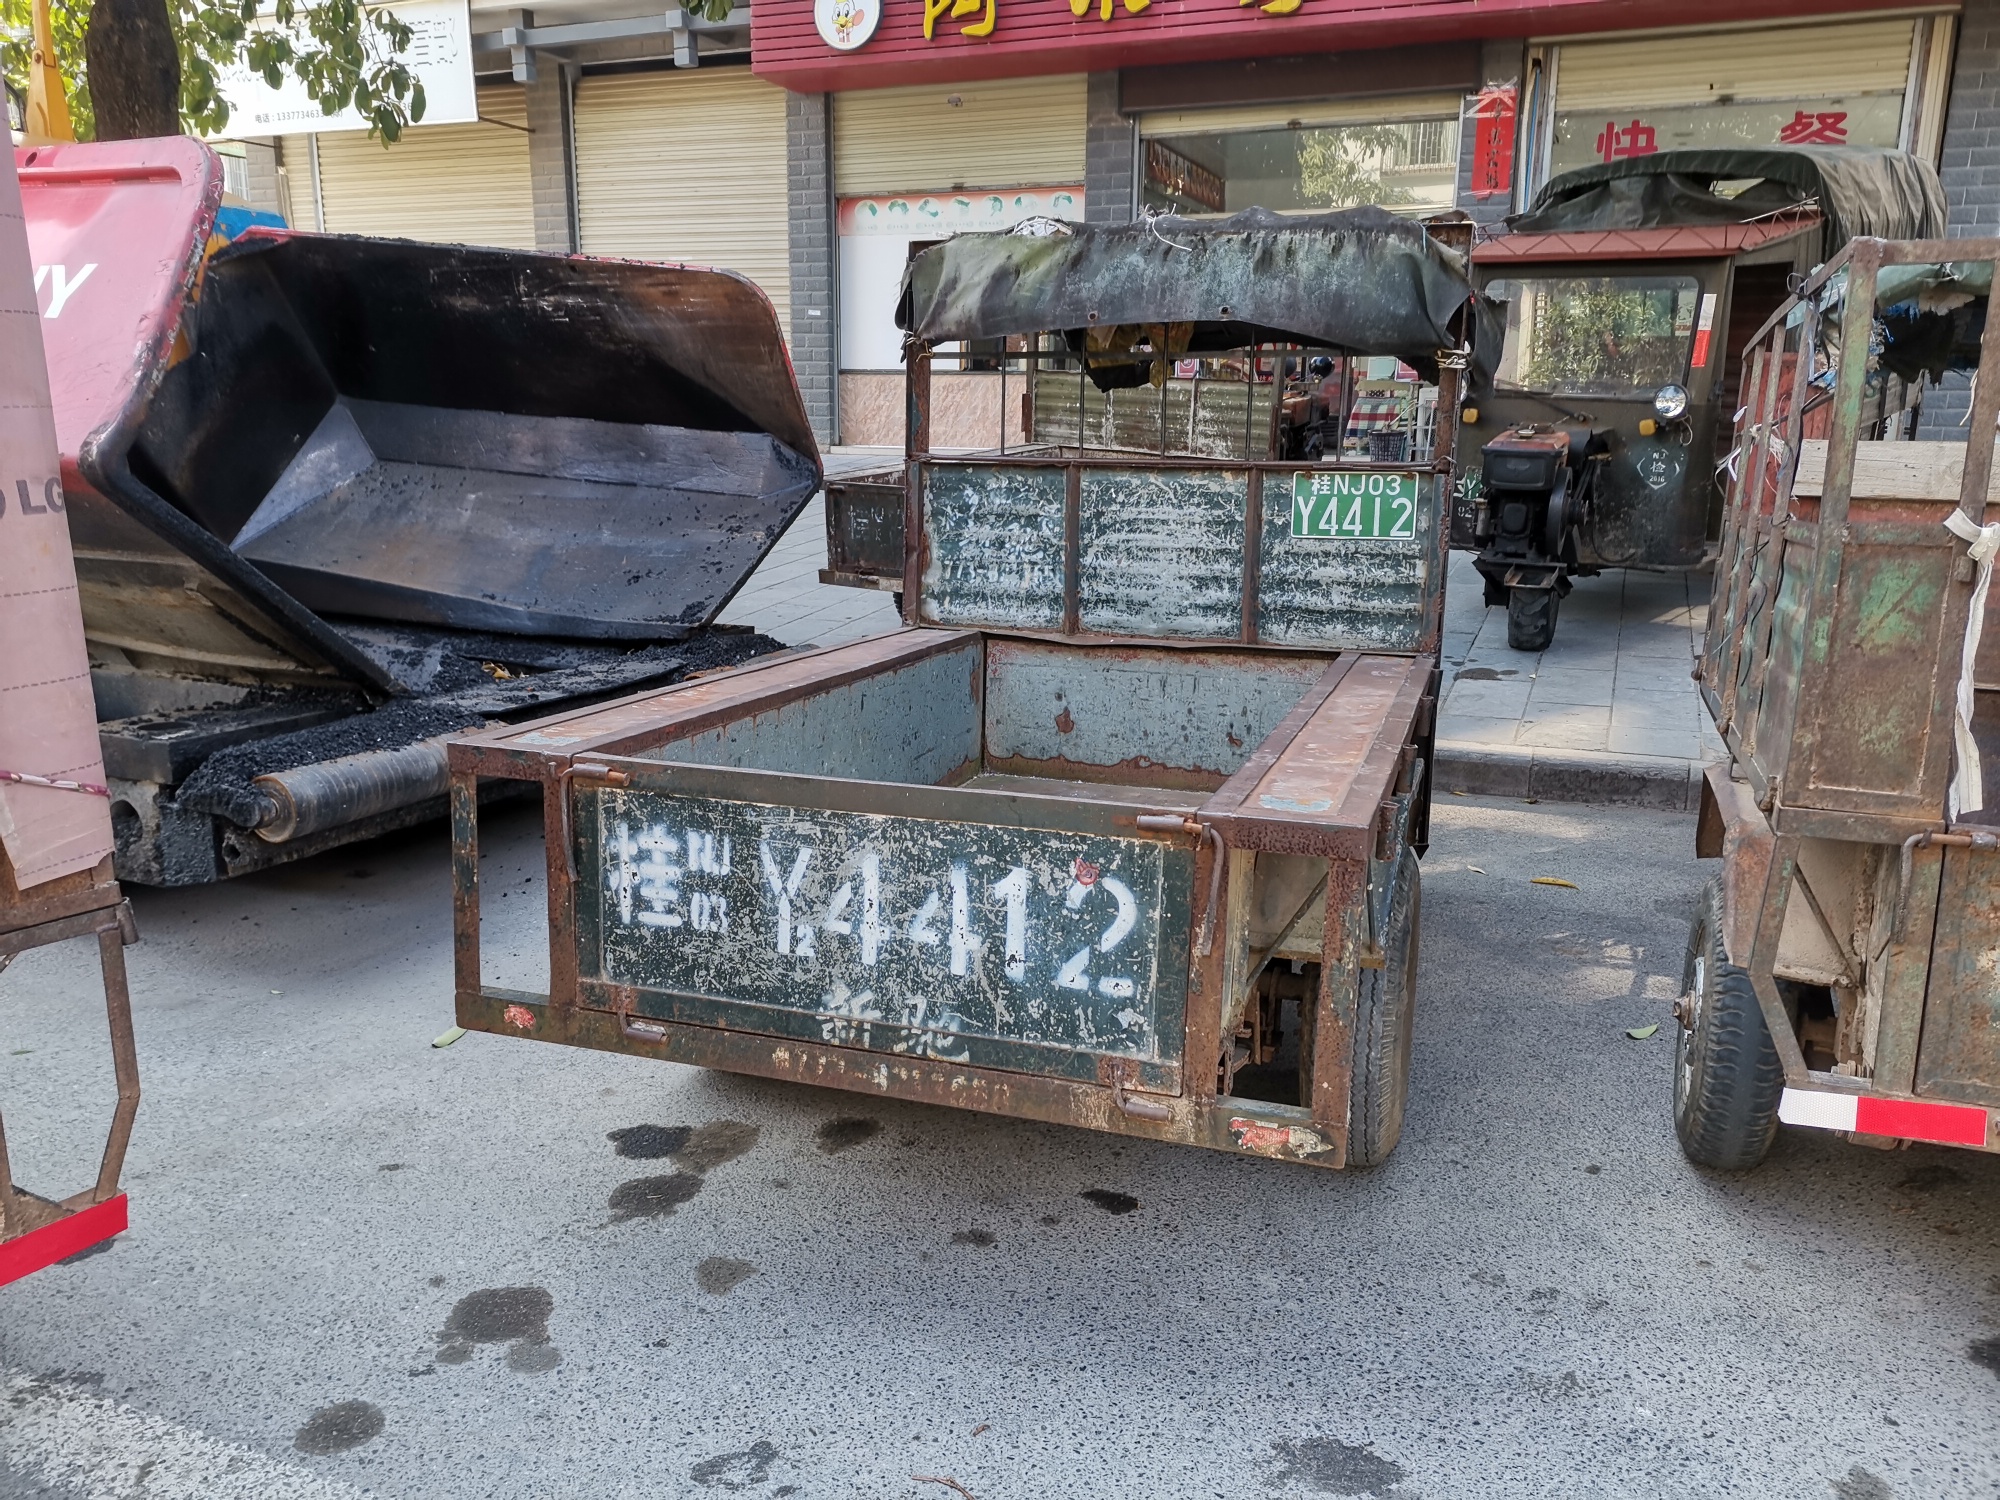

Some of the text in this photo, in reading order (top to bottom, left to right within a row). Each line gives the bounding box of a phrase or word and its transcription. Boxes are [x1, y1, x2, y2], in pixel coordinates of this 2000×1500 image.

[1650, 461, 1666, 473] 检
[1312, 474, 1401, 496] 桂NJ03
[1297, 496, 1413, 537] Y4412
[761, 839, 1138, 999] Y4412
